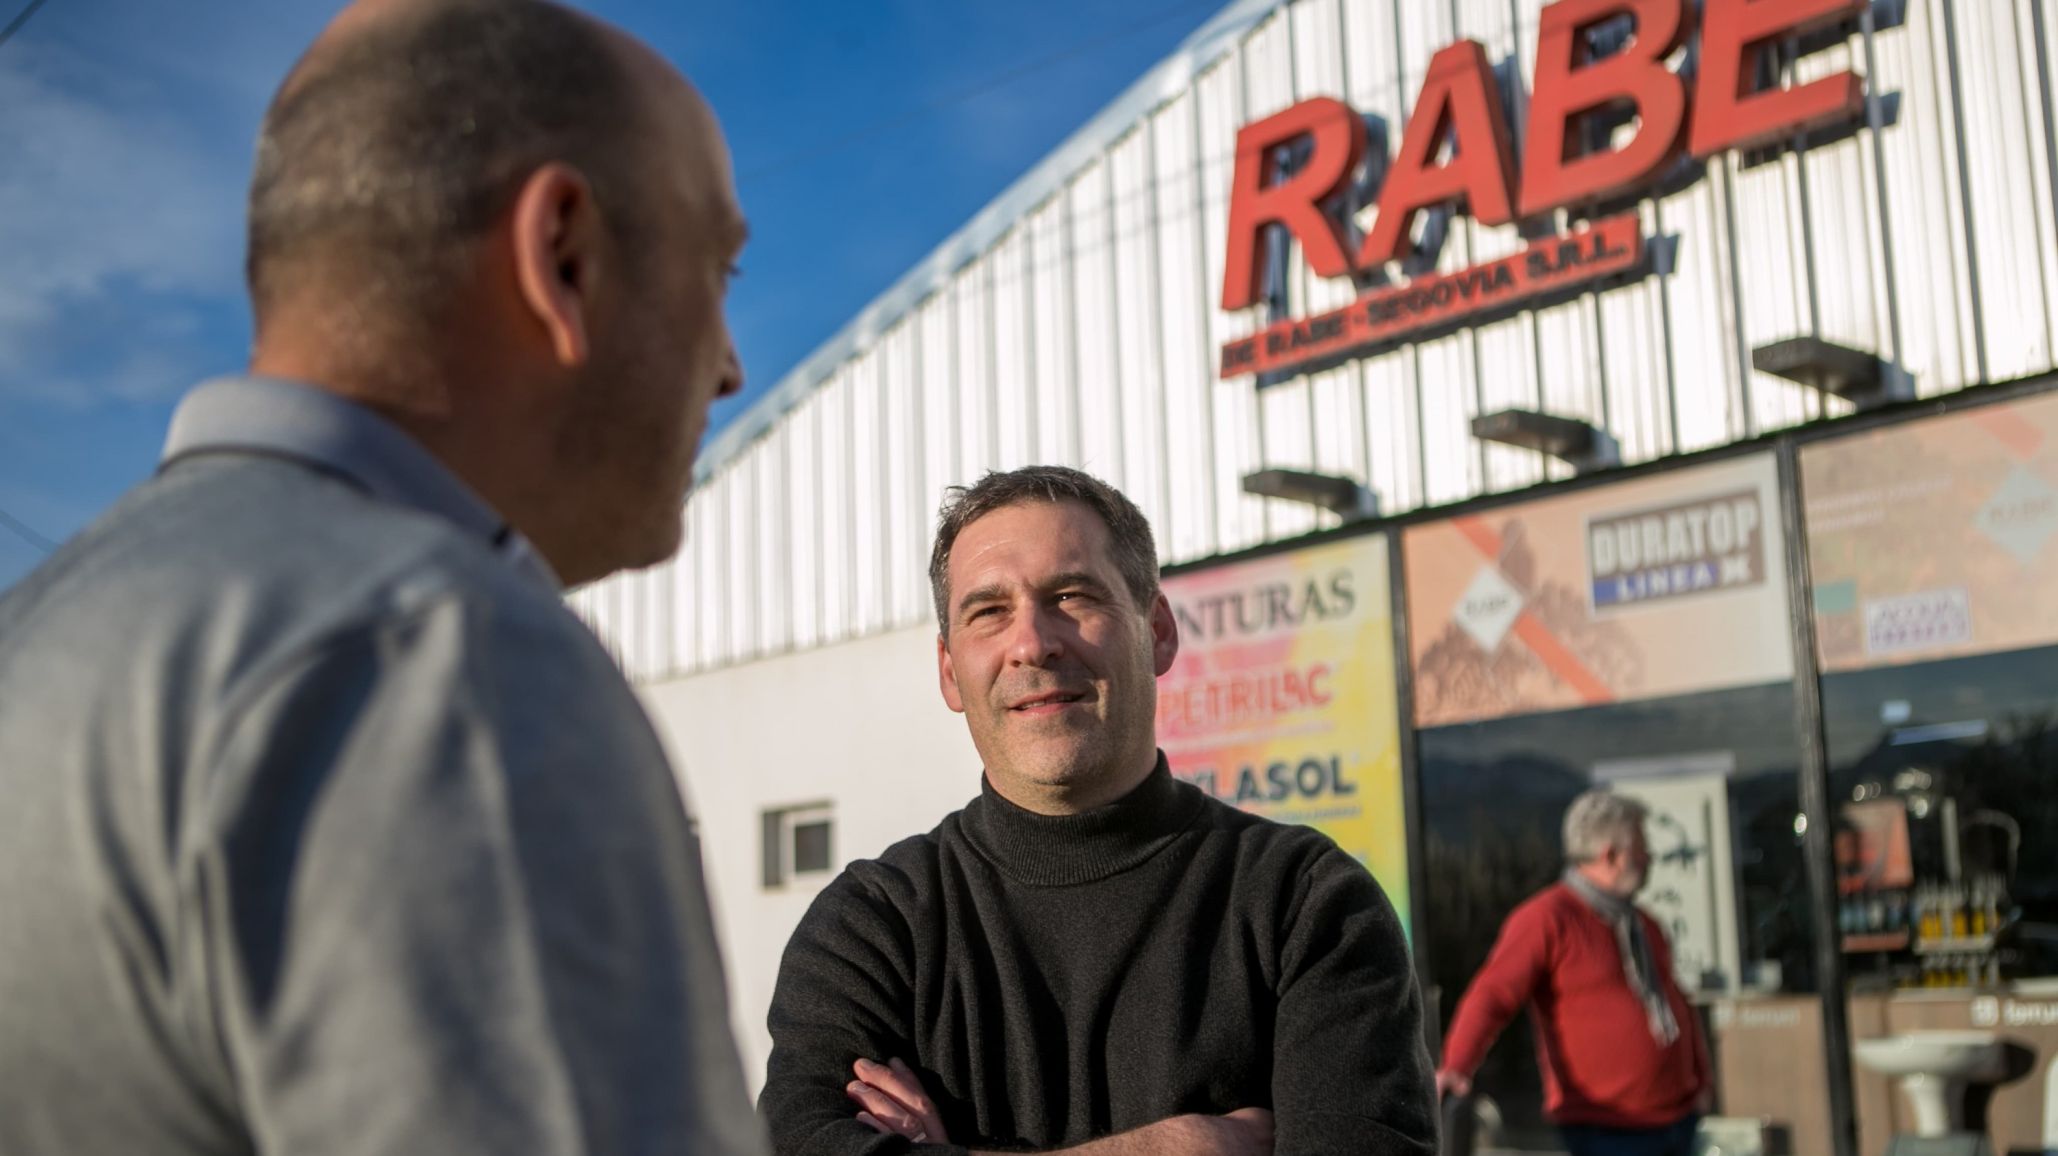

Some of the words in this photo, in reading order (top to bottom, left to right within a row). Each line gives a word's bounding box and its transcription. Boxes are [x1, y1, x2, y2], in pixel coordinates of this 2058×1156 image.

[1221, 0, 1867, 310] RABE
[1266, 314, 1346, 357] RABE
[1368, 261, 1515, 326] SEGOVIA
[1592, 500, 1759, 577] DURATOP
[1173, 567, 1356, 644] NTURAS
[1616, 559, 1718, 601] LINEA
[1177, 752, 1356, 806] LASOL
